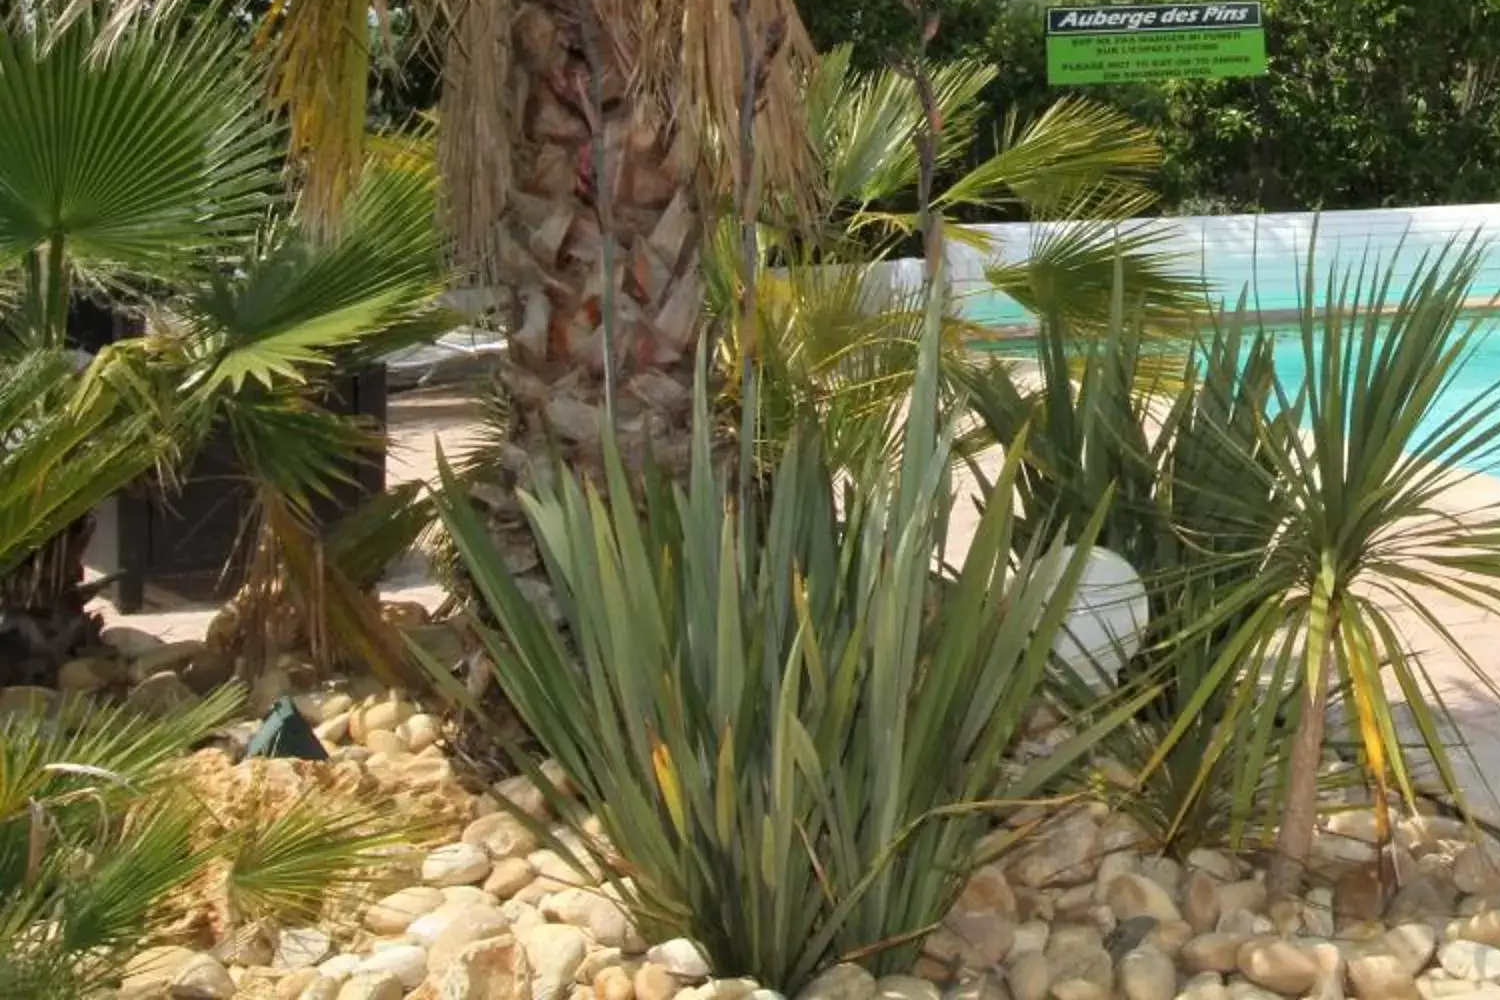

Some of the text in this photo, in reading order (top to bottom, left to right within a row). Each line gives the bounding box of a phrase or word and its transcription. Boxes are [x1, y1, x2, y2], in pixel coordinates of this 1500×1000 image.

[1058, 5, 1248, 28] Auberge des Pins
